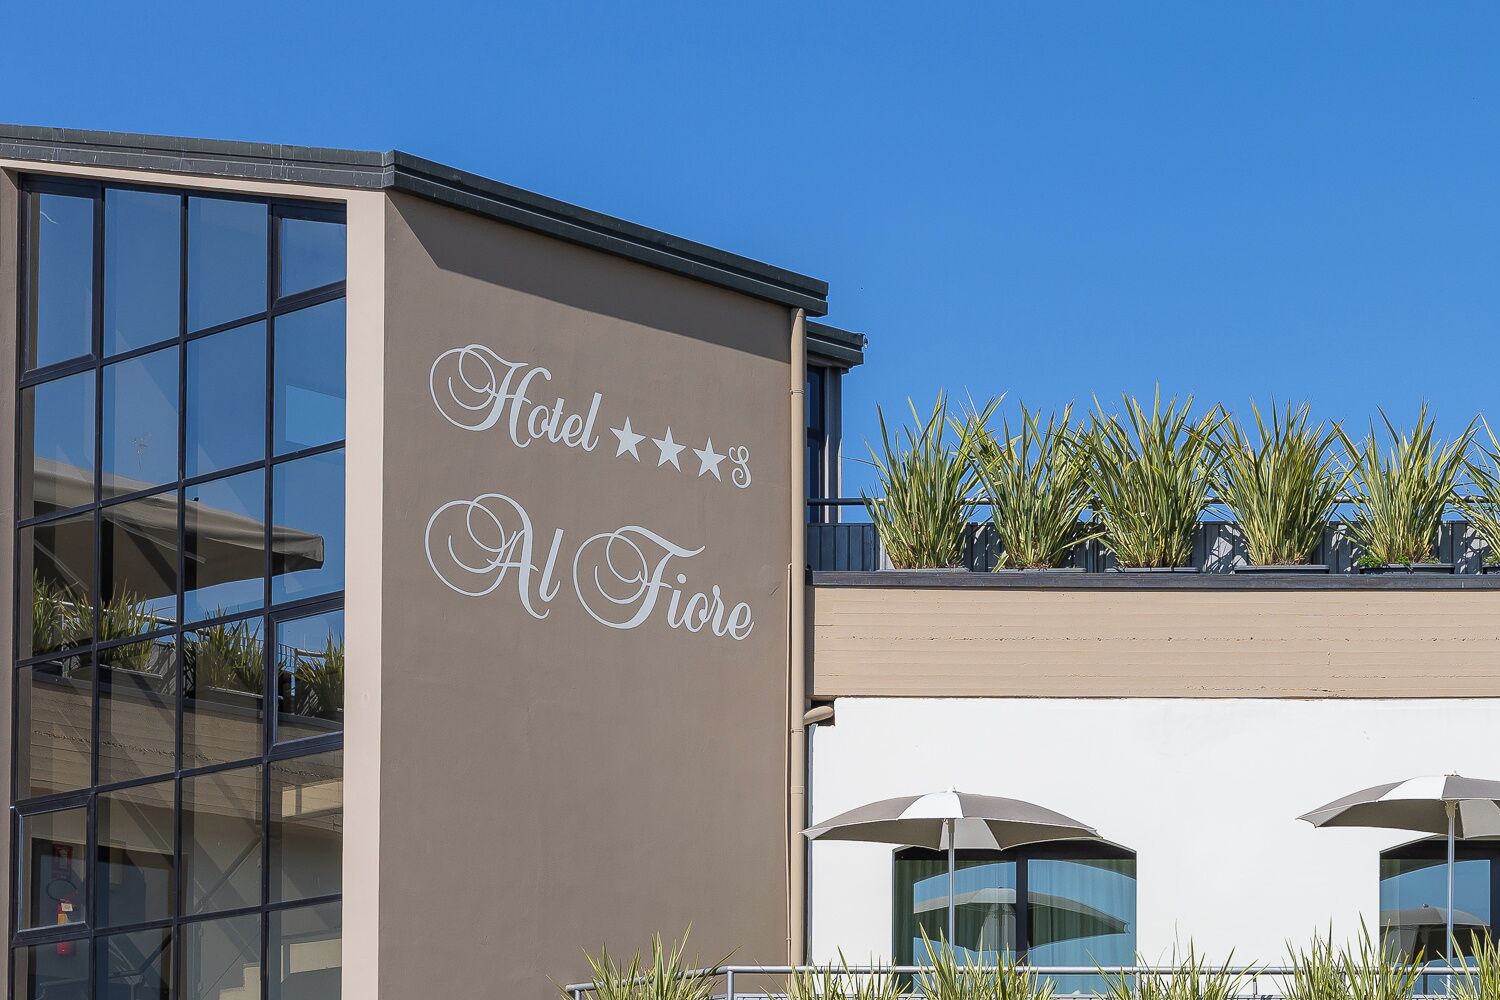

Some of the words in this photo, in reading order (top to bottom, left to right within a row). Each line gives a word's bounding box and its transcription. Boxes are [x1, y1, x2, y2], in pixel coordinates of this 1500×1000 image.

[429, 343, 603, 453] Hotel
[424, 492, 565, 620] Al
[573, 525, 755, 641] Fiore
